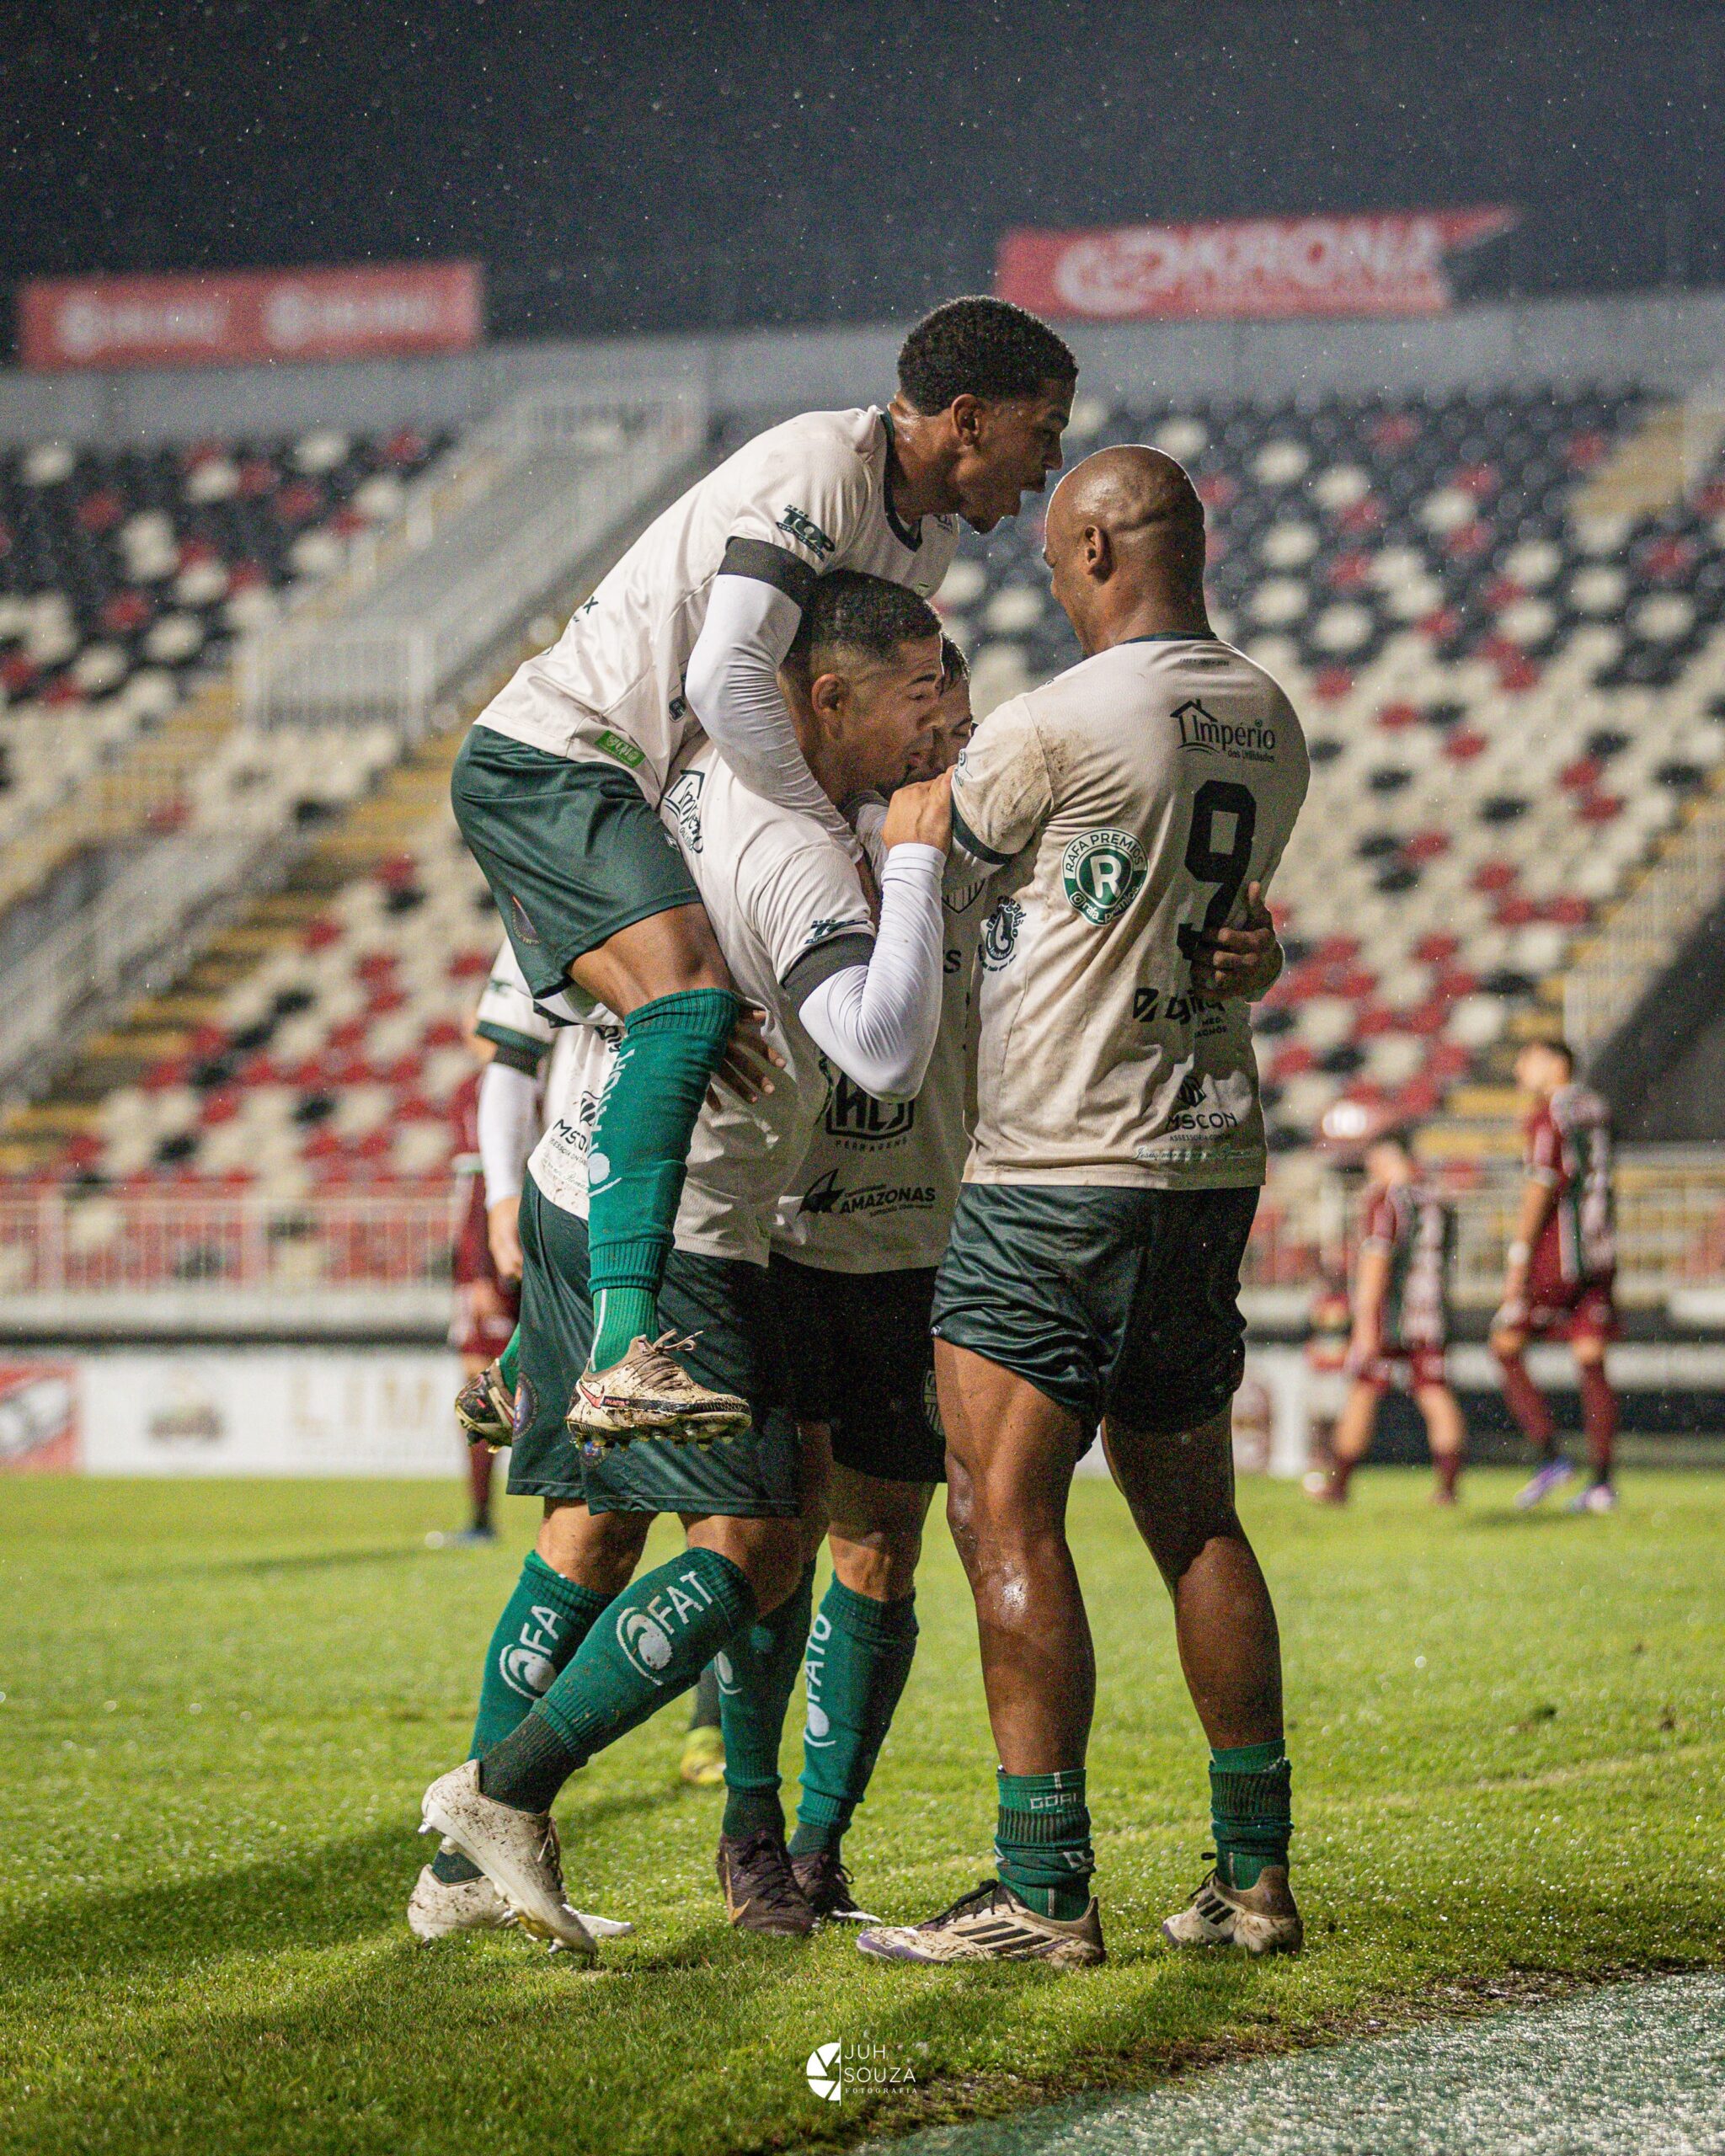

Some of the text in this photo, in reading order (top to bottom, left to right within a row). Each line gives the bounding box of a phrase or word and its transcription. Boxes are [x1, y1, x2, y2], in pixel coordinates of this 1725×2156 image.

[1065, 833, 1144, 873] RAFA PREMIOS
[1089, 854, 1123, 899] R
[1177, 780, 1257, 969] 9
[1166, 1112, 1238, 1129] MSCON
[840, 1187, 937, 1214] AMAZONAS
[804, 1613, 832, 1702] FATO
